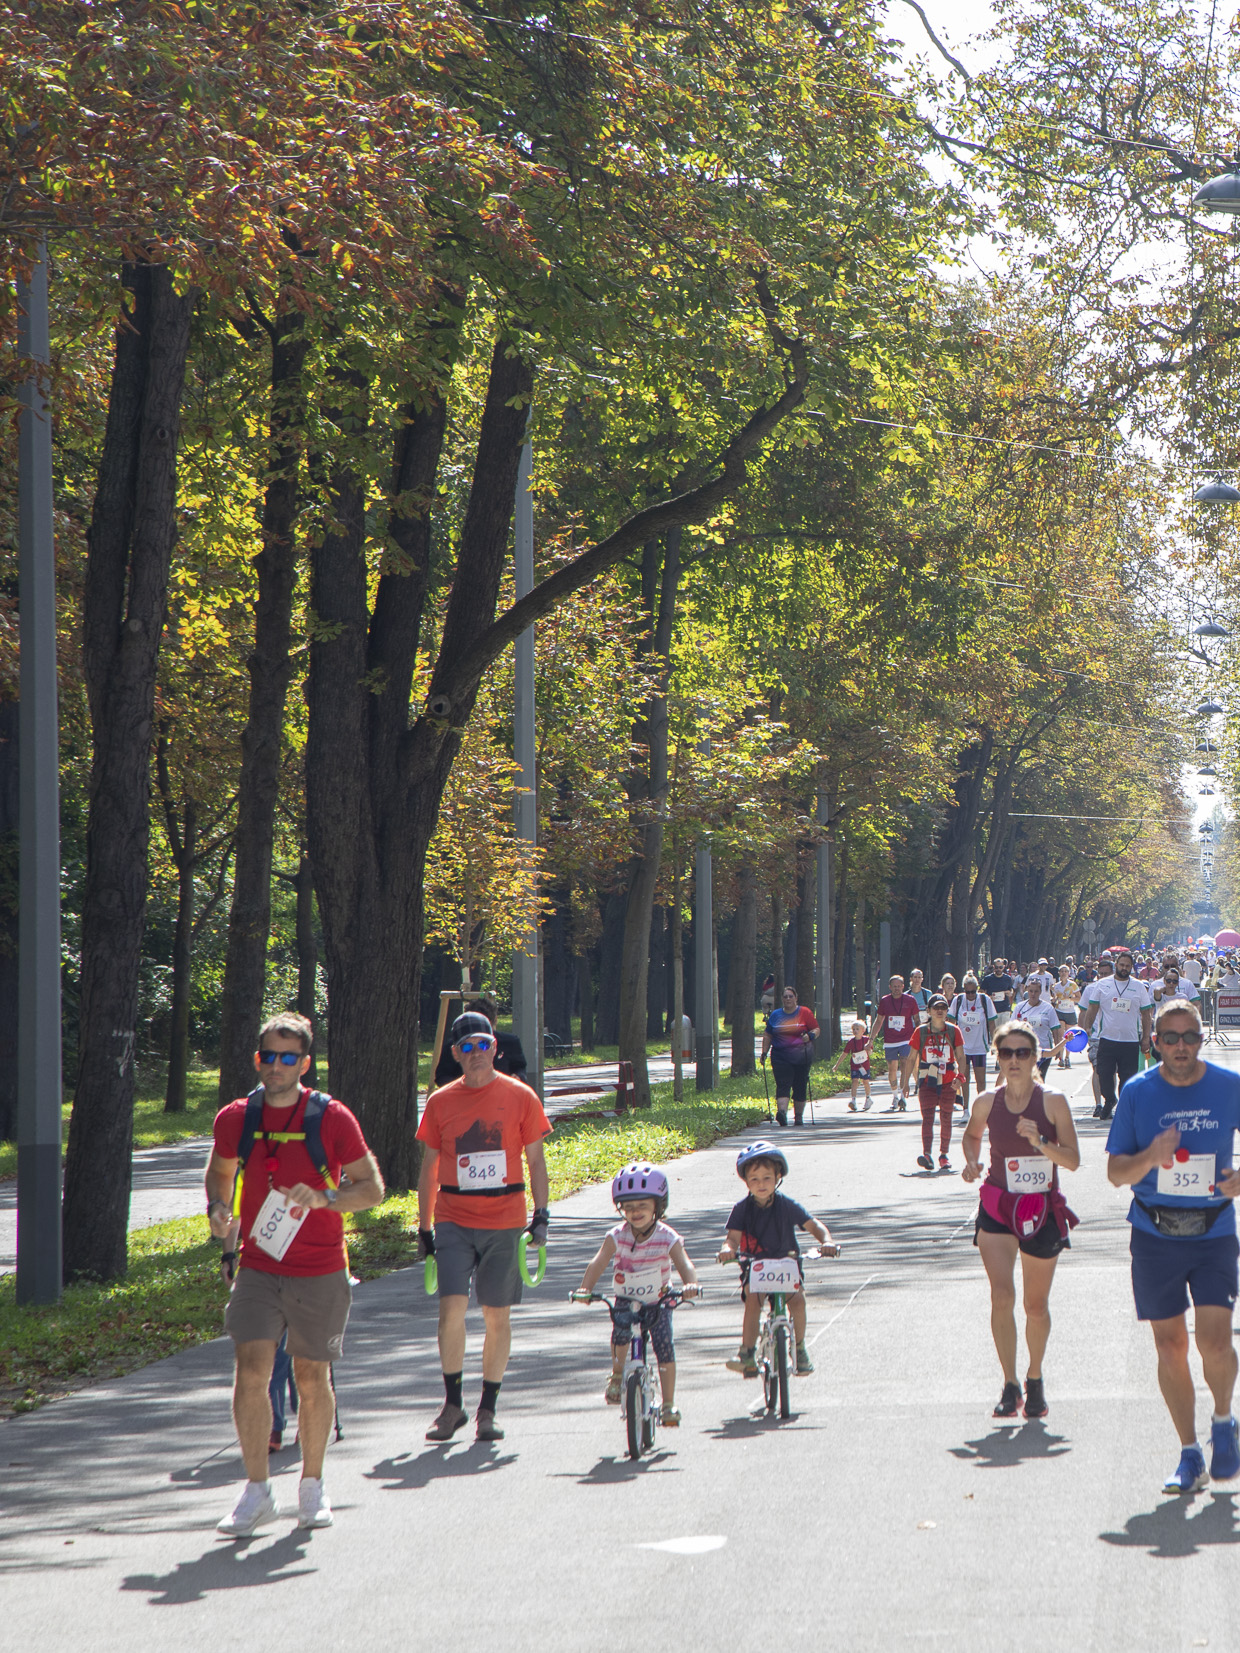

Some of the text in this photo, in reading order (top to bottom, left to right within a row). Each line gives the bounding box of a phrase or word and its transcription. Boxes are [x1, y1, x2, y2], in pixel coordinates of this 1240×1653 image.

[1164, 1109, 1212, 1120] miteinander
[468, 1164, 497, 1180] 848
[1014, 1171, 1046, 1185] 2039
[1173, 1172, 1200, 1187] 352
[260, 1207, 287, 1240] 1203
[758, 1272, 791, 1284] 2041
[622, 1285, 654, 1296] 1202
